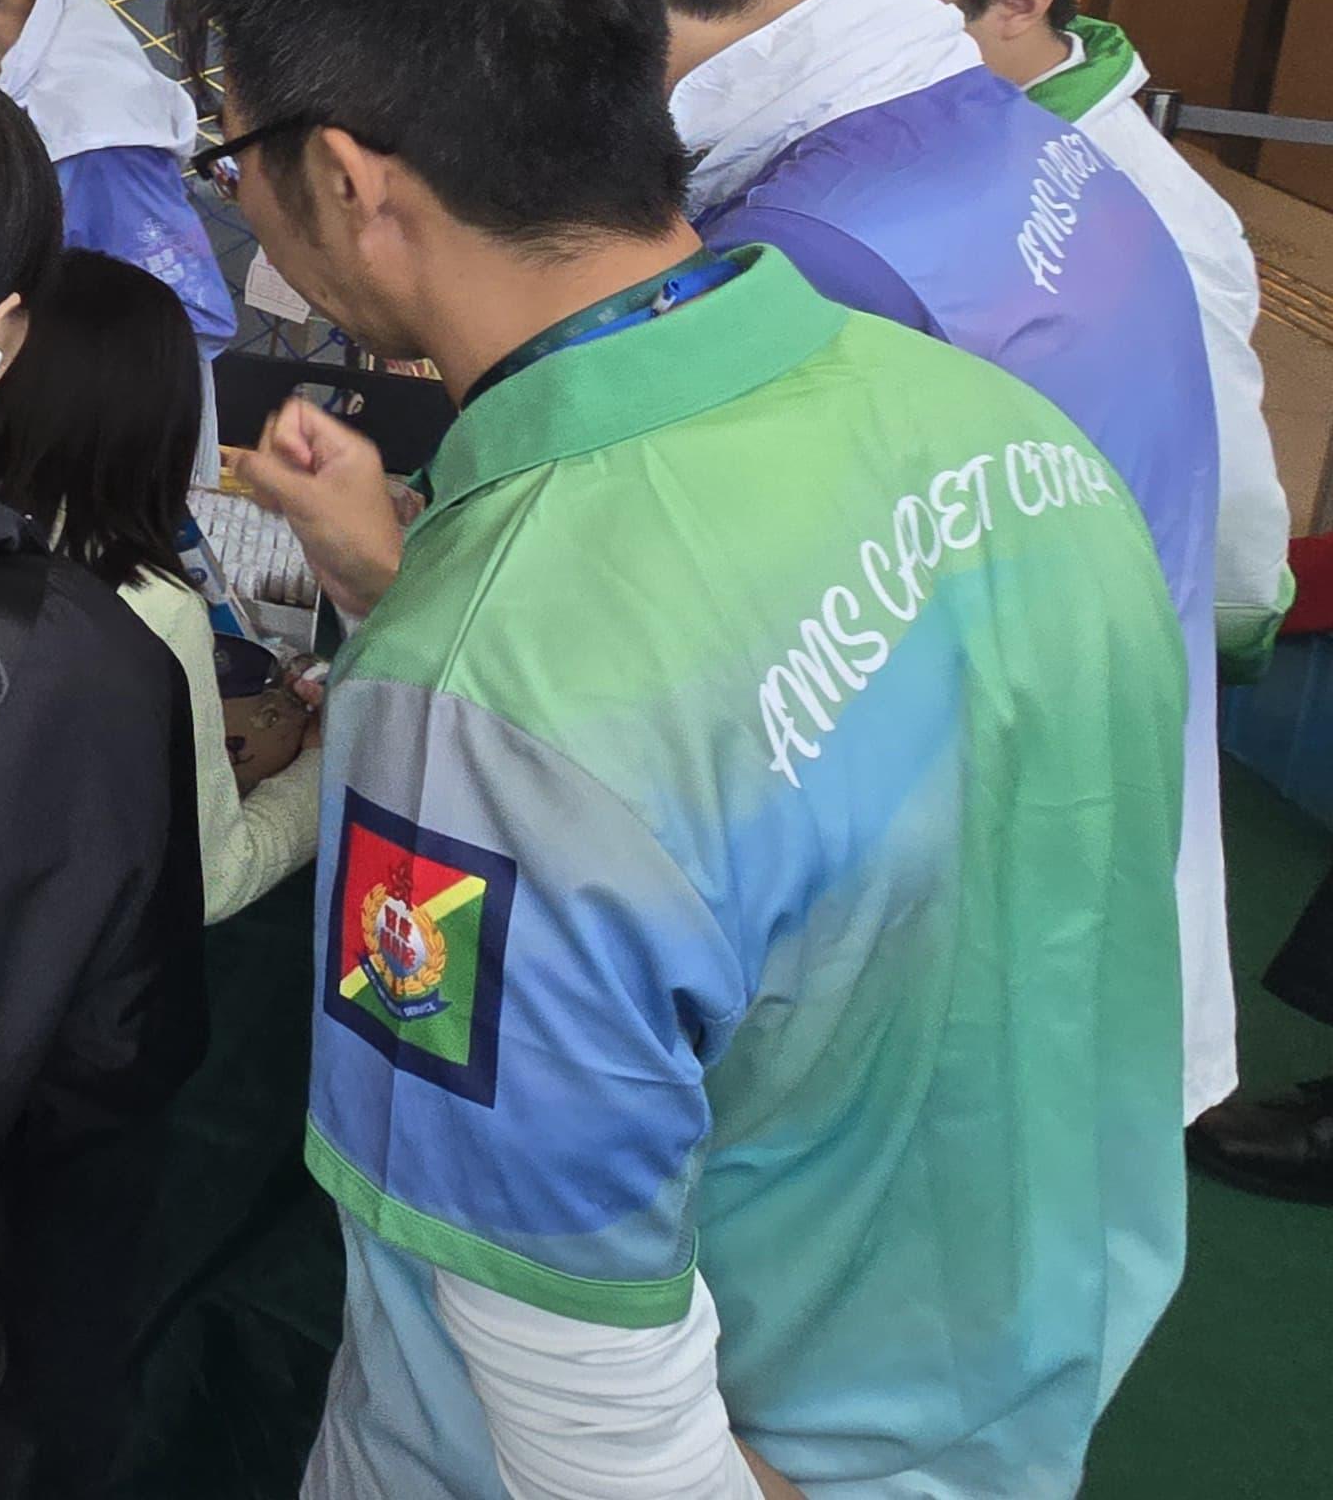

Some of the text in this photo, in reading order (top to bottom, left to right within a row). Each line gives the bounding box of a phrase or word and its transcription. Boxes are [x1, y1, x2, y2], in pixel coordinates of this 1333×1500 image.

[1017, 178, 1079, 295] AMS
[757, 584, 891, 789] AMS
[860, 454, 996, 622] CADET
